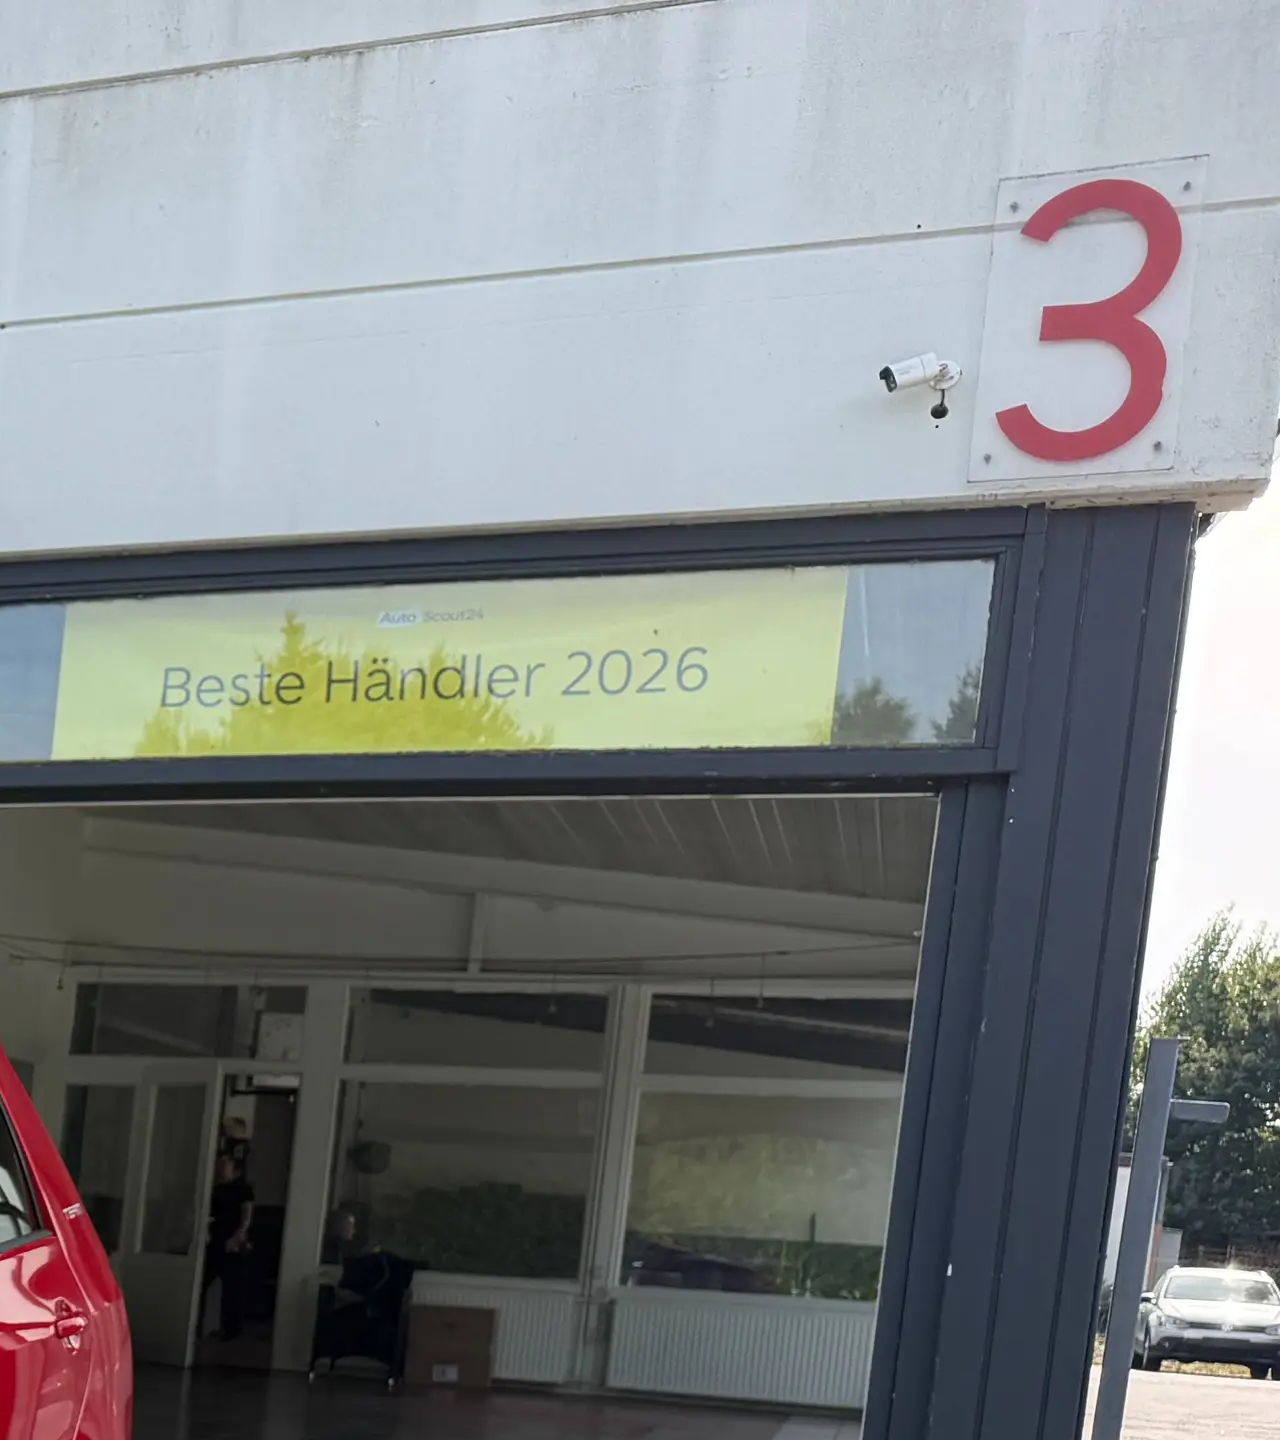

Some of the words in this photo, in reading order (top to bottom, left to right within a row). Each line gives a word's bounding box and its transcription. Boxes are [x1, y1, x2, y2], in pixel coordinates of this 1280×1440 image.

[996, 179, 1182, 462] 3
[159, 665, 306, 708] Beste
[324, 654, 545, 703] Händler
[560, 646, 710, 697] 2026
